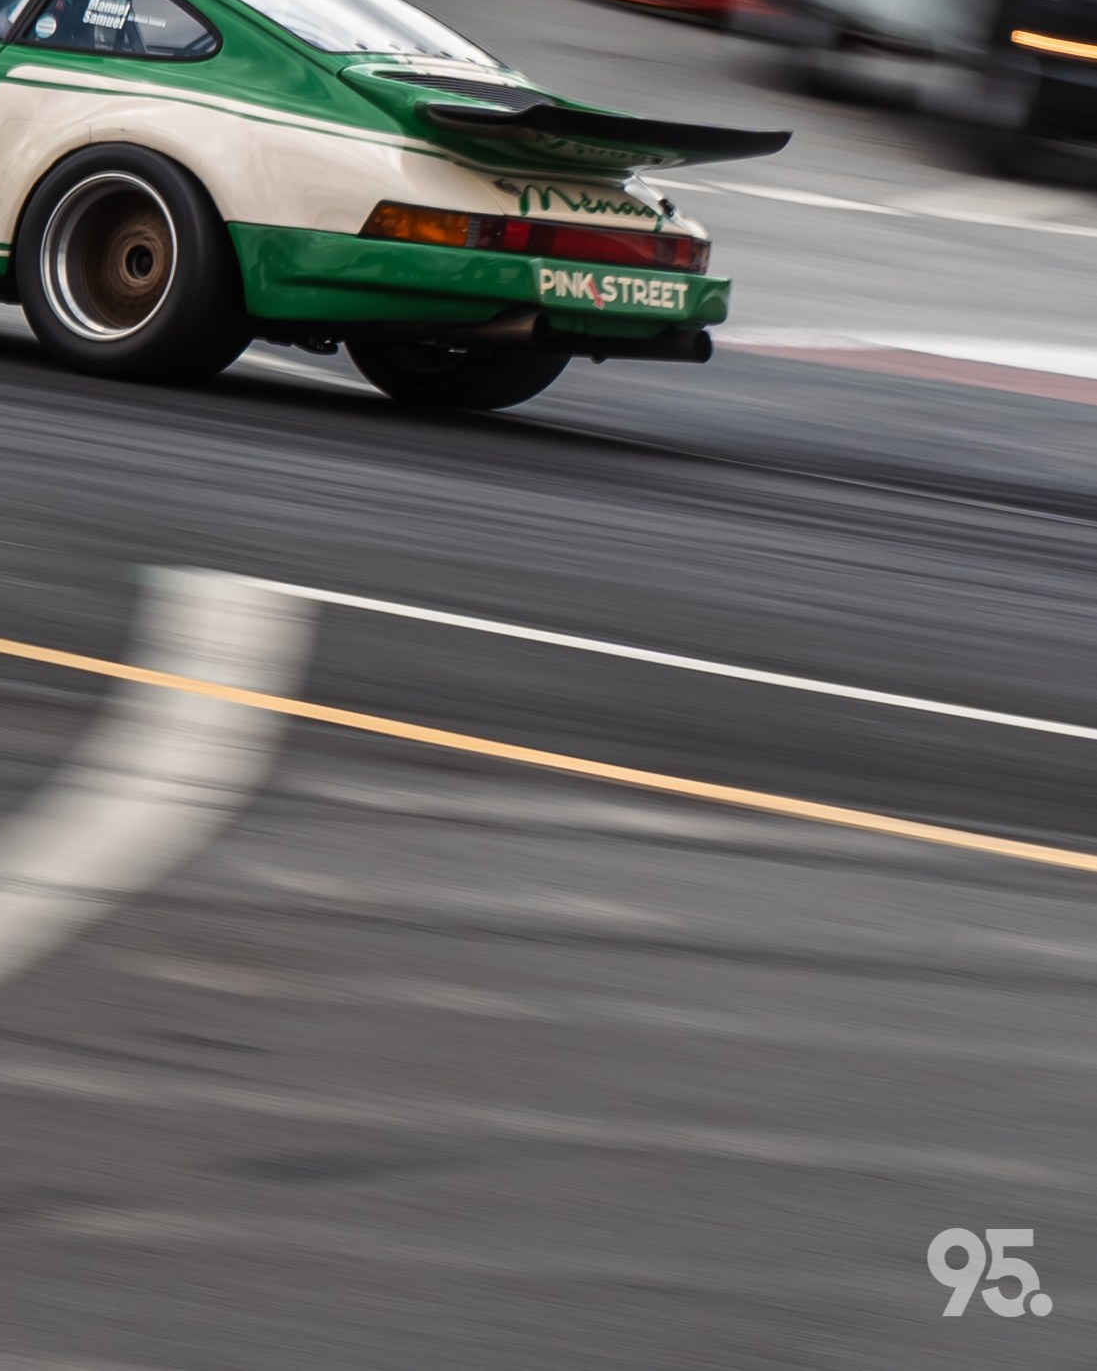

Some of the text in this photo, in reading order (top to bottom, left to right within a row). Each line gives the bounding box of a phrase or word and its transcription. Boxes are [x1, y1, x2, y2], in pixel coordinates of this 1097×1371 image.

[83, 10, 125, 29] Samuel
[539, 268, 689, 311] PINK STREET
